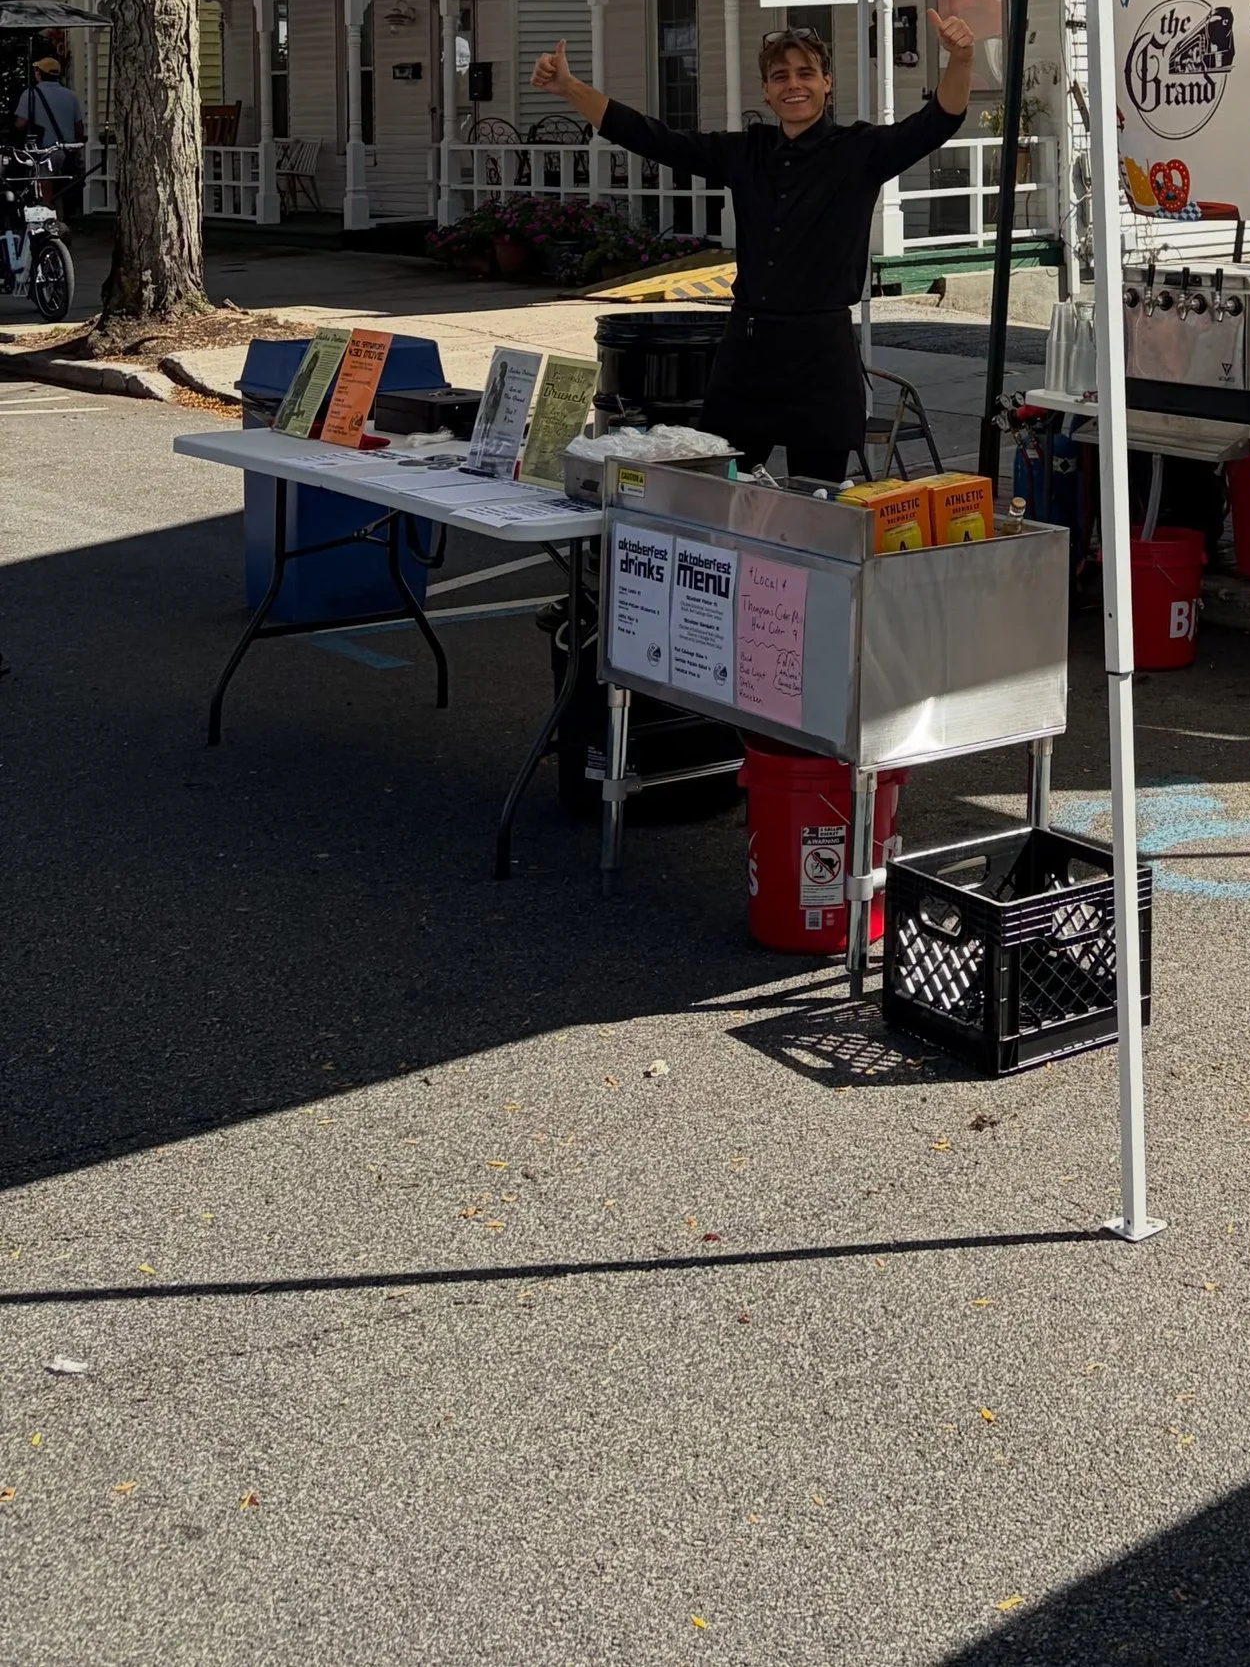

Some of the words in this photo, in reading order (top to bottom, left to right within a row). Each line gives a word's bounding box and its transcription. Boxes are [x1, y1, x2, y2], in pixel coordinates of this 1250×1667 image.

[1160, 7, 1191, 39] the
[1124, 32, 1217, 112] Grand
[543, 382, 587, 404] Brunch
[879, 497, 920, 518] ATHLETIC
[945, 489, 984, 508] ATHLETIC
[887, 515, 908, 525] BREWING
[952, 505, 973, 515] BREWING
[618, 538, 668, 561] oktoberfest
[620, 552, 664, 583] drinks
[678, 550, 731, 575] oktoberfest
